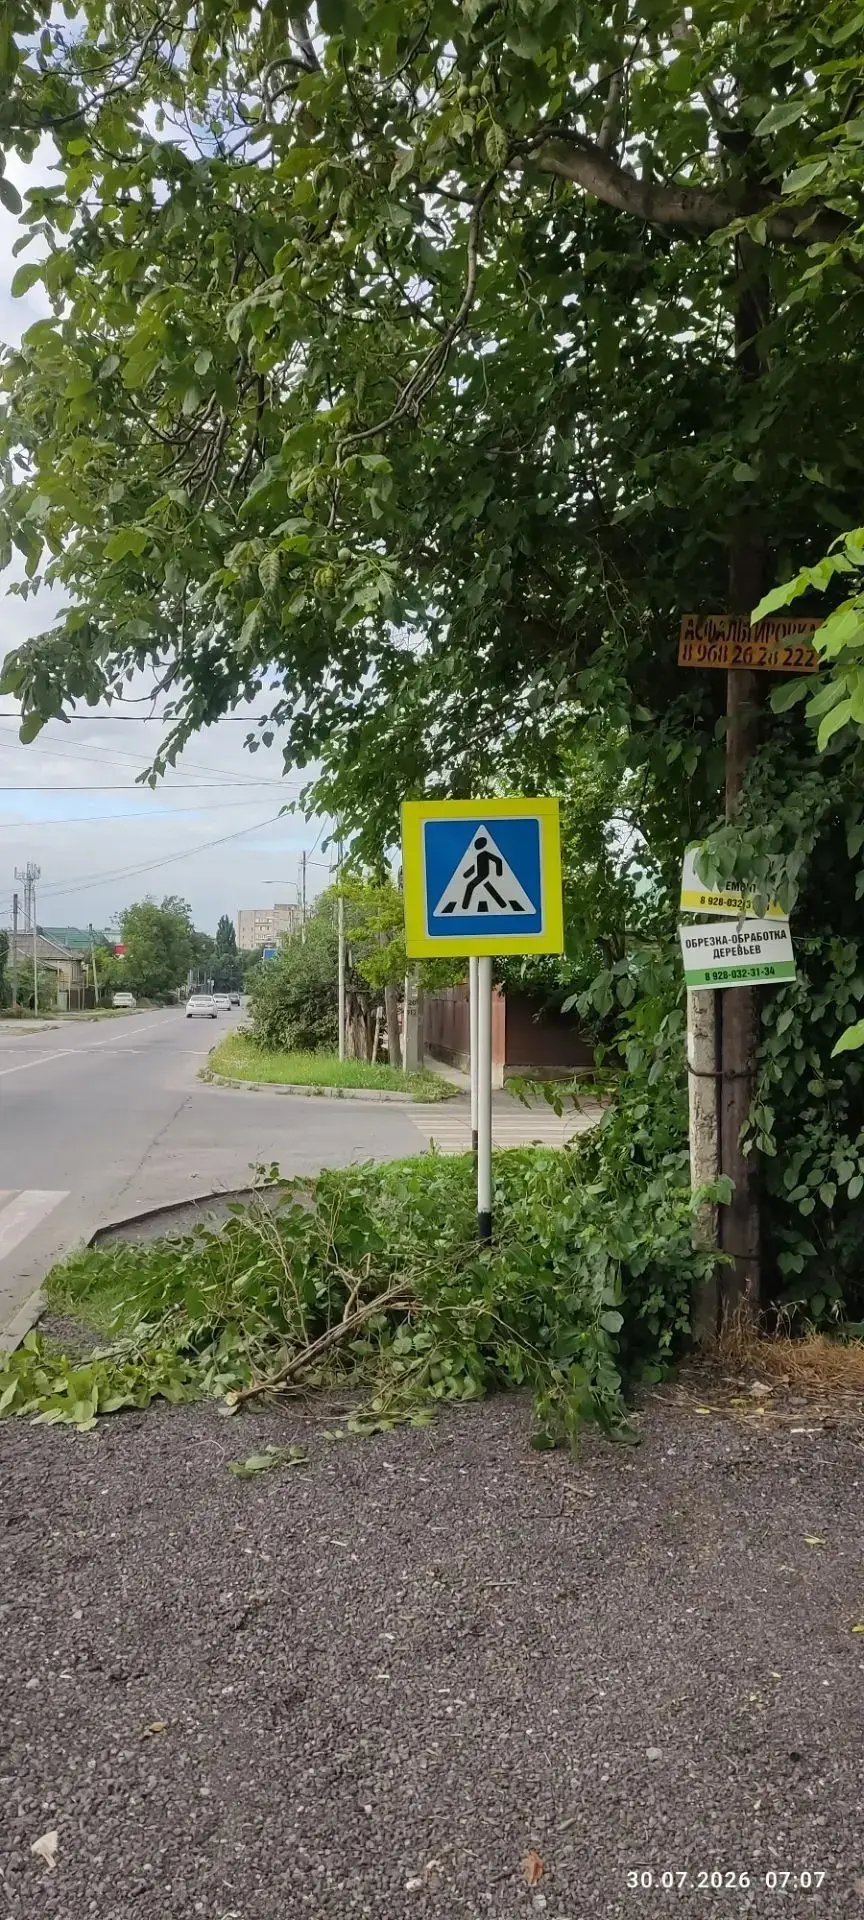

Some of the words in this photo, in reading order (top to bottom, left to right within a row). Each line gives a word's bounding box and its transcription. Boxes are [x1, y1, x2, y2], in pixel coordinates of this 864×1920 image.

[682, 644, 692, 661] 8
[697, 644, 728, 662] 968
[731, 645, 753, 664] 26
[758, 647, 778, 666] 28
[782, 648, 815, 667] 222
[700, 895, 706, 904] 8
[685, 929, 788, 949] ОБРЕЗКА-ОБРАБОТКА
[713, 944, 762, 960] ДЕРЕВЬЕВ
[704, 971, 711, 981] 8
[712, 966, 776, 981] 928-032-31-34
